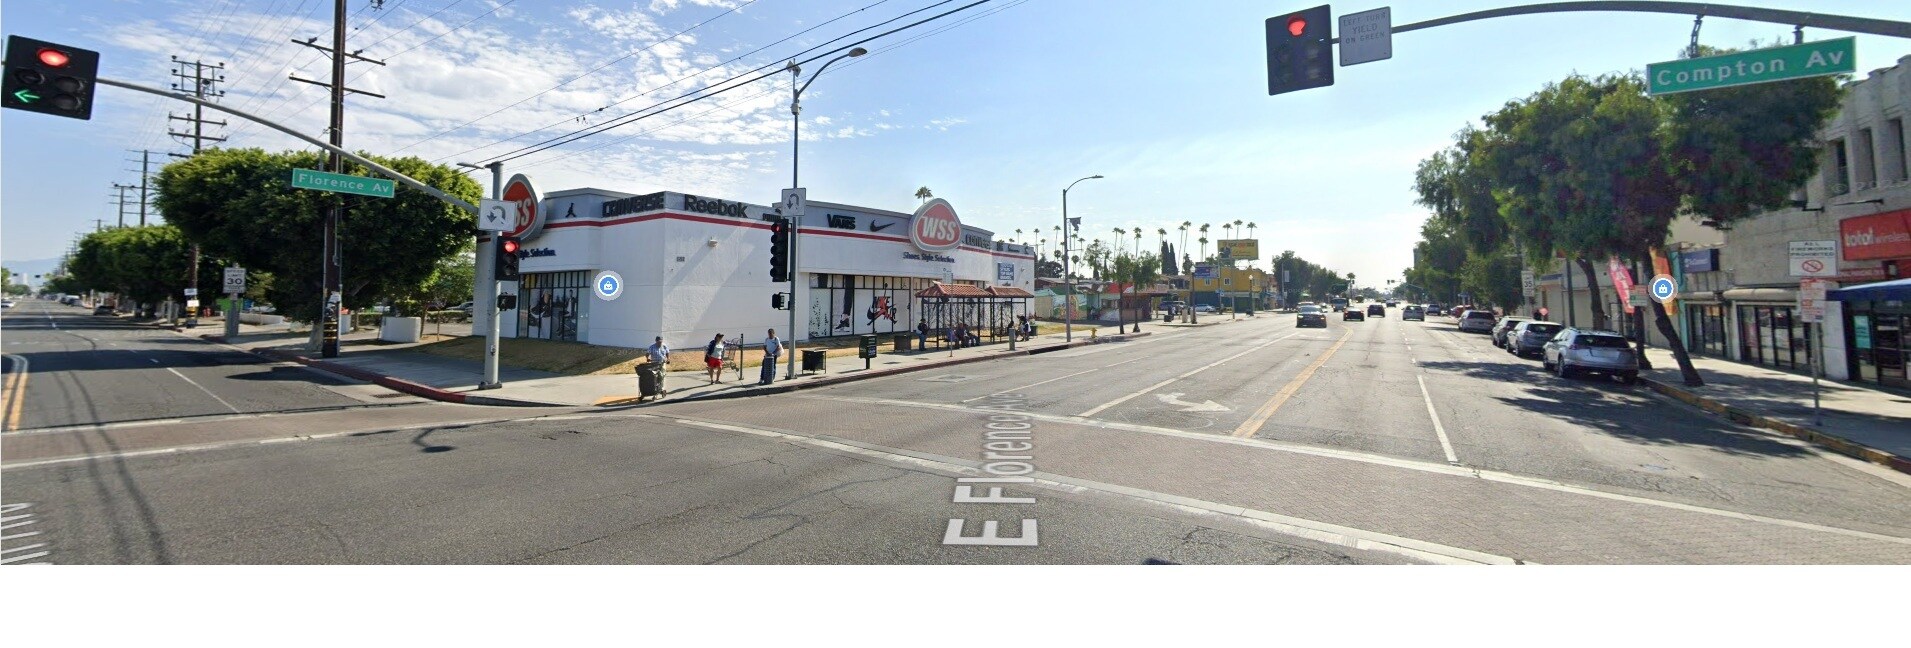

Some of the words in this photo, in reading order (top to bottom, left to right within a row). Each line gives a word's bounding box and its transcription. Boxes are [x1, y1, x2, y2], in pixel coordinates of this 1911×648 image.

[1343, 17, 1361, 27] LEFT
[1365, 11, 1386, 22] TURN
[1353, 23, 1378, 34] YIELD
[1360, 31, 1385, 42] GREEN
[1656, 58, 1786, 86] Compton
[1805, 50, 1845, 68] Av
[298, 173, 364, 190] Florence
[372, 183, 389, 193] Av
[684, 193, 749, 219] Reebok
[922, 215, 956, 241] WSS
[1844, 226, 1874, 247] total
[1524, 280, 1533, 288] 35
